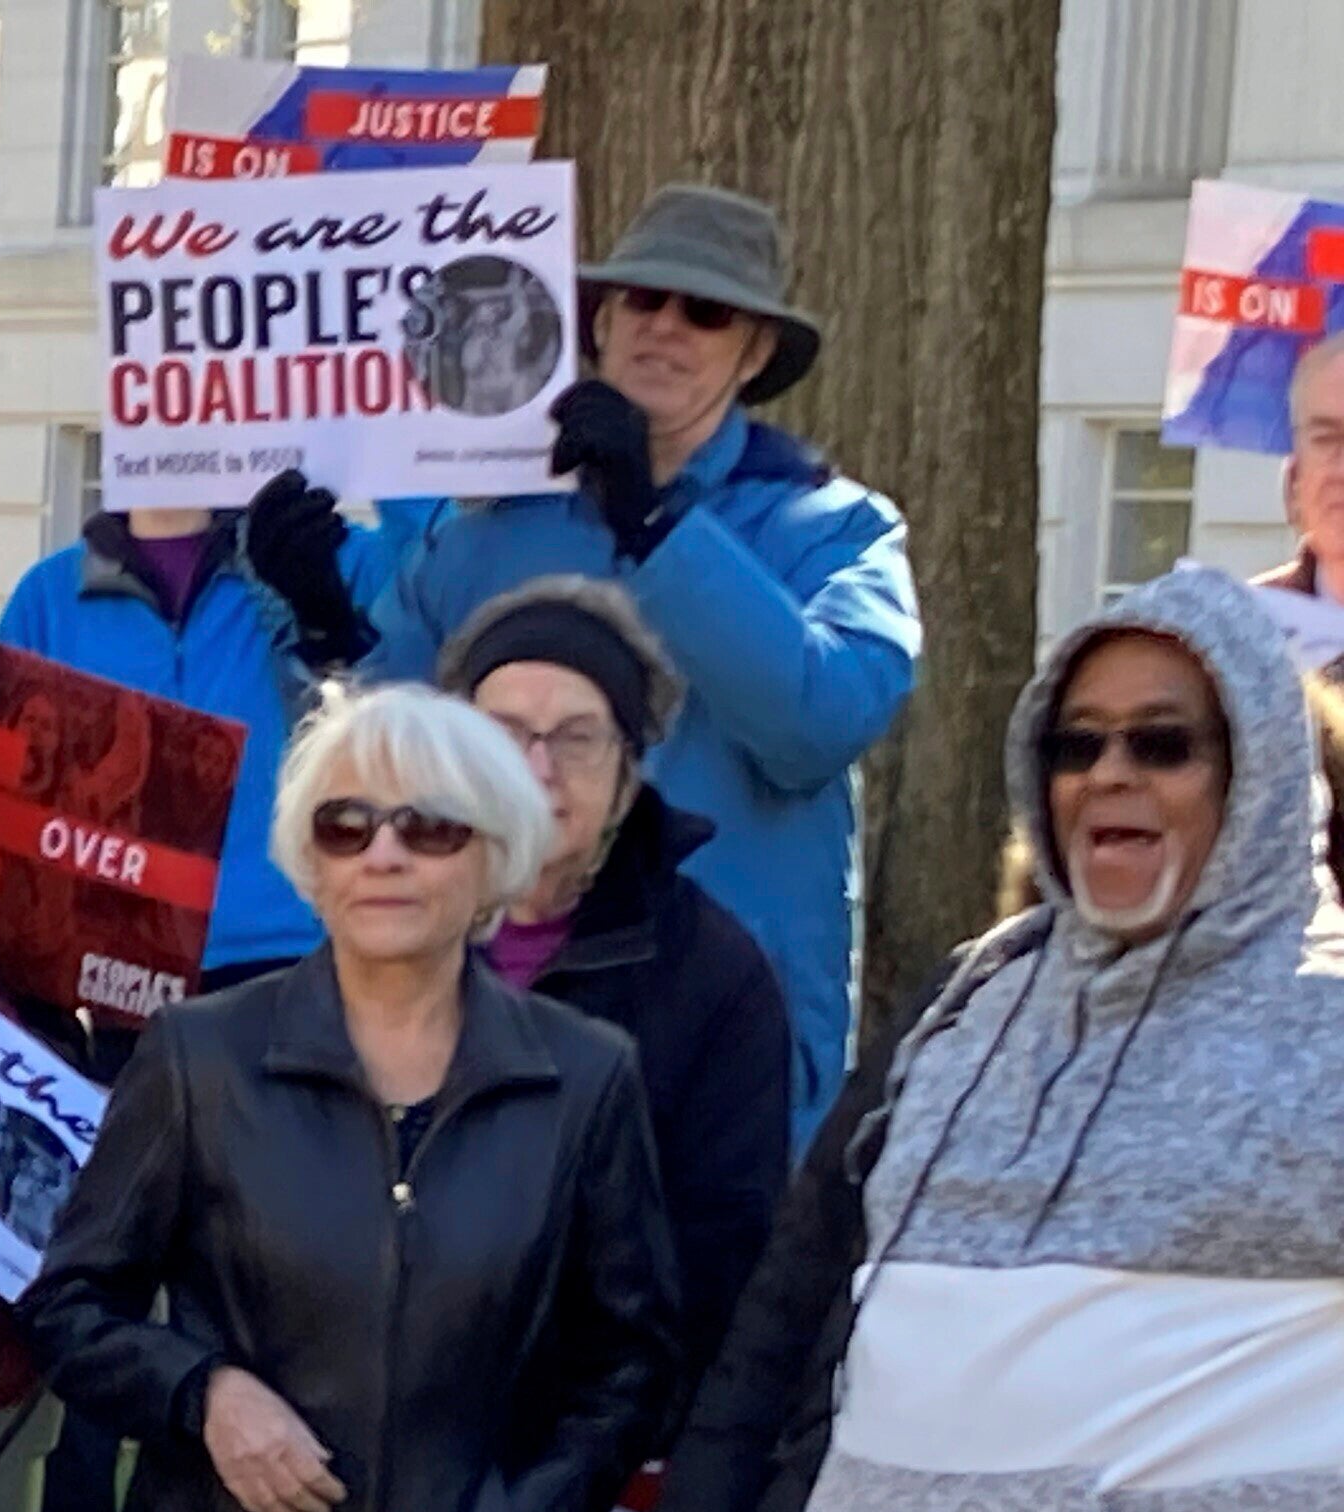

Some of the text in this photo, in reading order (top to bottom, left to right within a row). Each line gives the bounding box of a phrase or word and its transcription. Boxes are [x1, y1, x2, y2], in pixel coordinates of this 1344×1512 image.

[348, 99, 496, 139] JUSTICE
[181, 138, 291, 179] IS ON
[107, 188, 557, 261] We are the
[110, 264, 442, 356] PEOPLE'S
[1191, 276, 1293, 326] IS ON
[111, 349, 440, 427] COALITION
[40, 816, 148, 886] OVER
